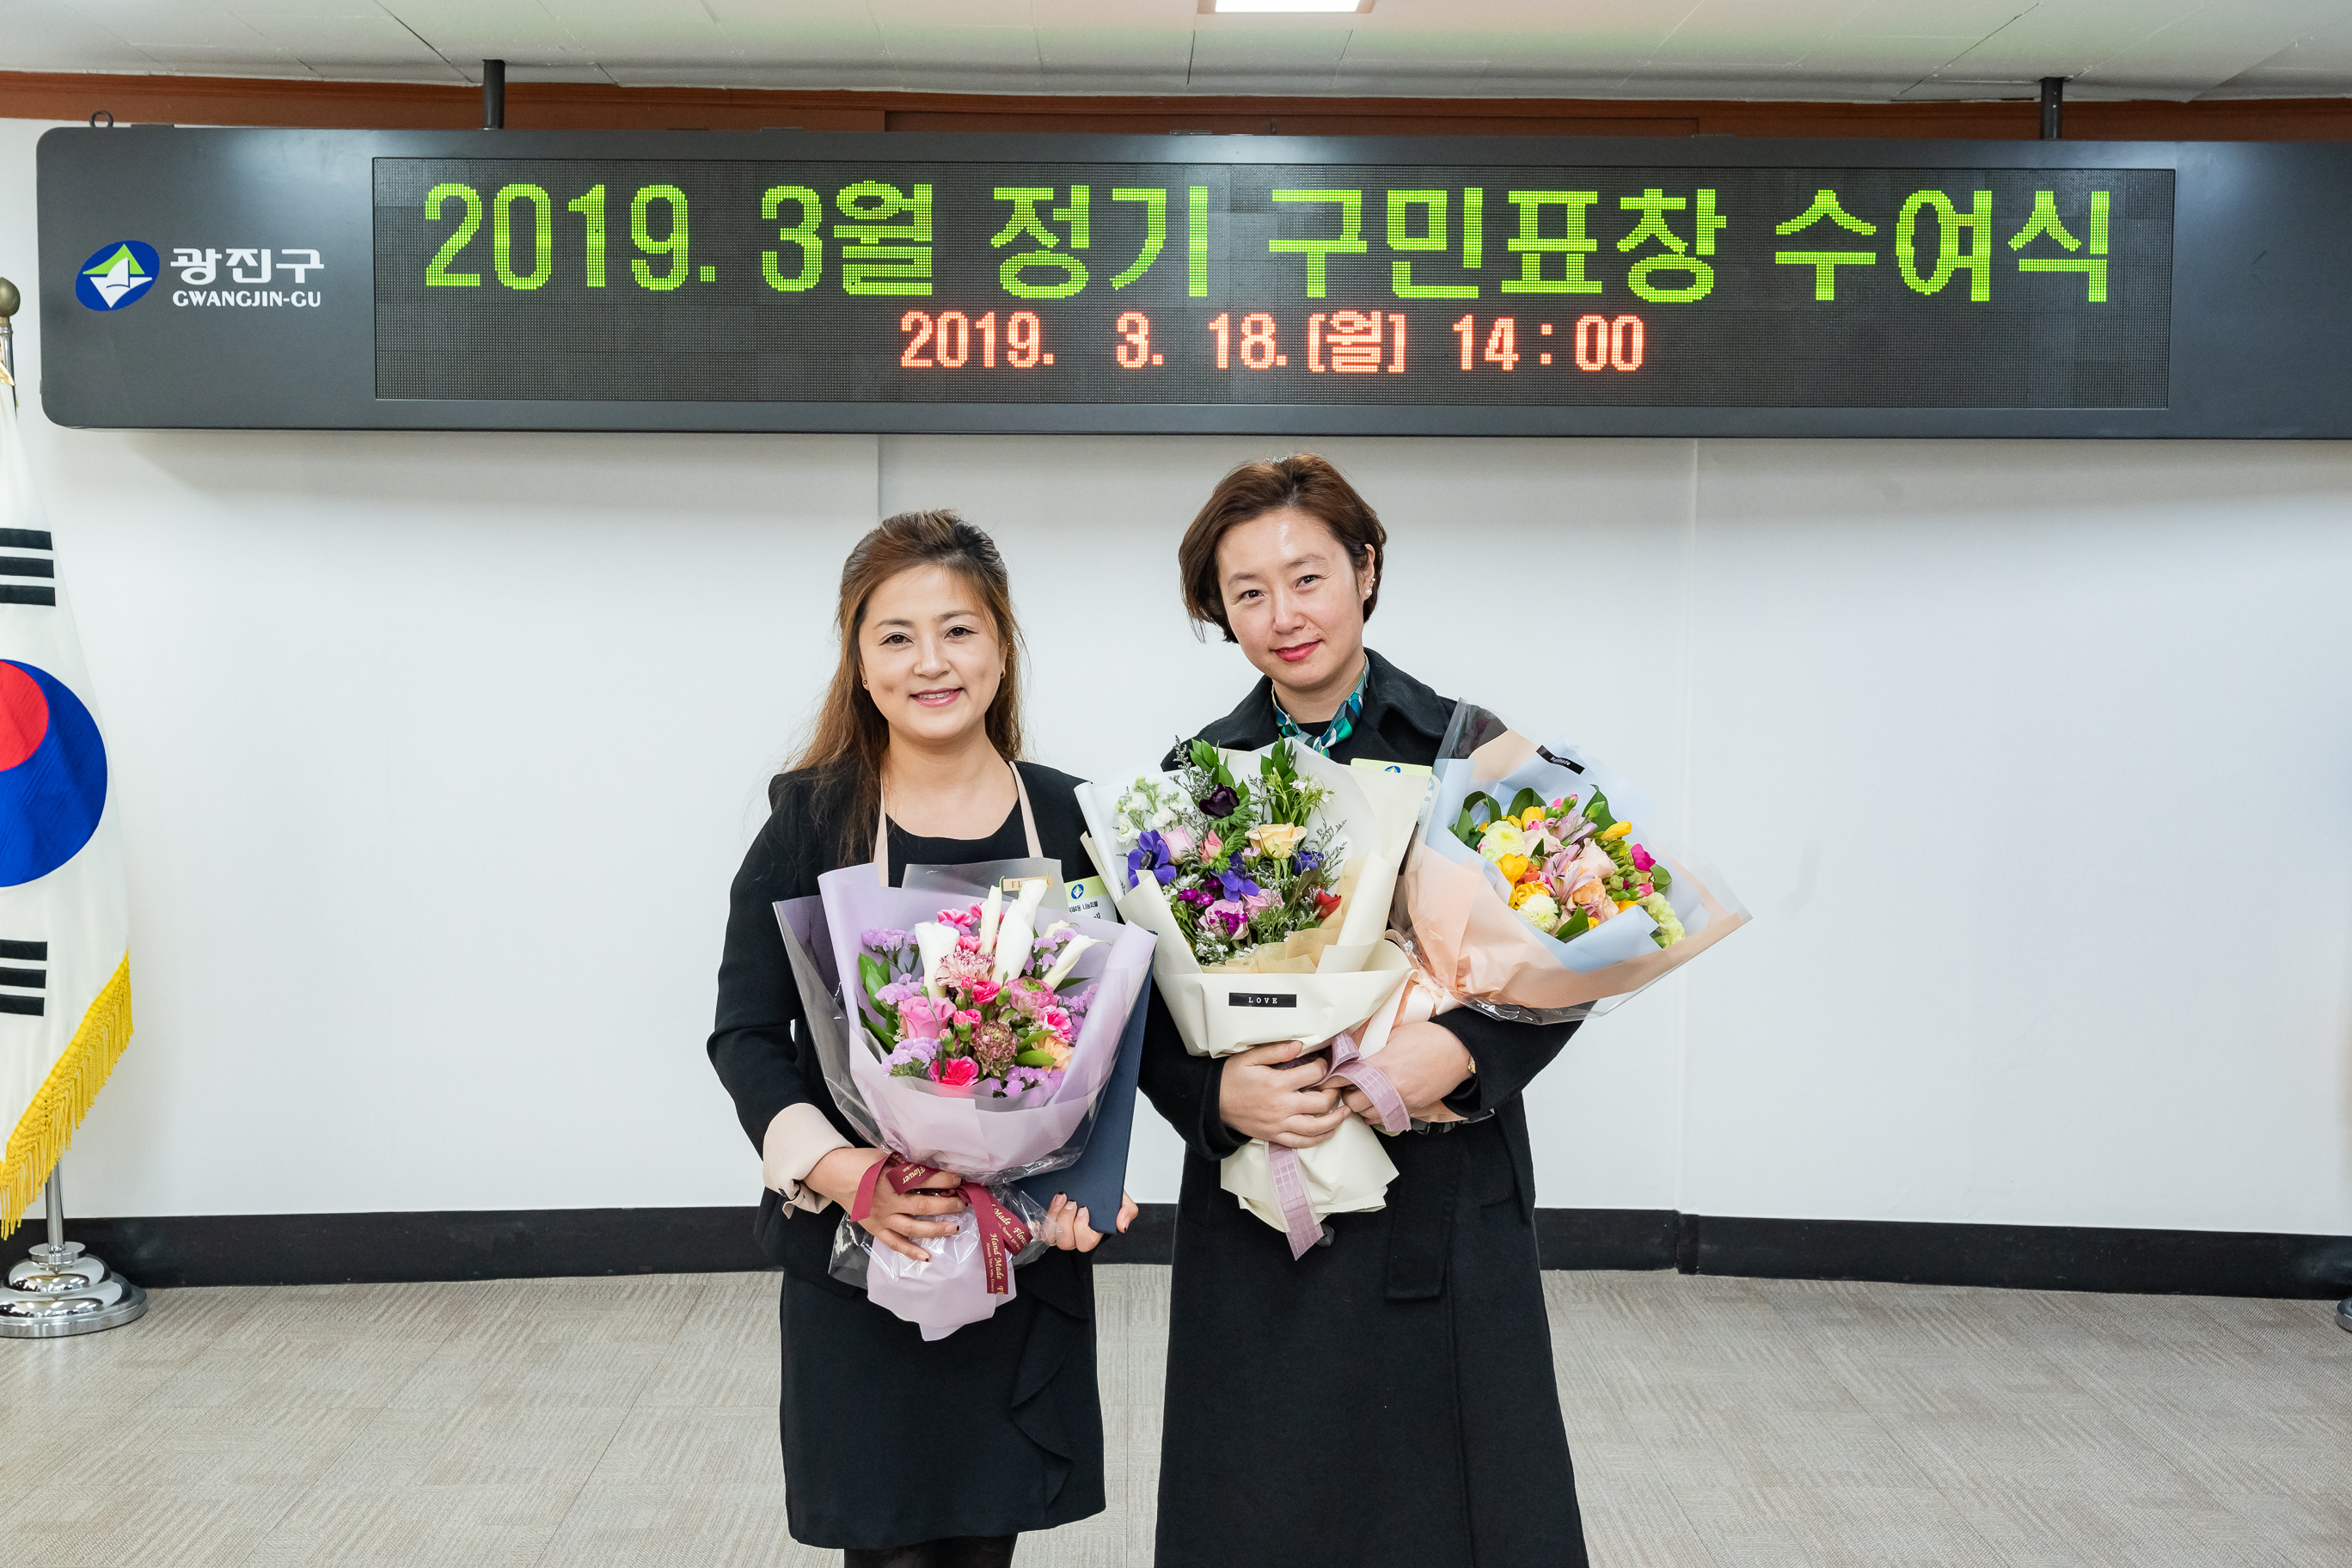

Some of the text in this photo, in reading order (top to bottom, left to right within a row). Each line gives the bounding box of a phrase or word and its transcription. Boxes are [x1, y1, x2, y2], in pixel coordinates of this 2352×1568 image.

[425, 180, 2110, 303] 2019. 3월 정기 구민표창 수여식
[170, 248, 325, 285] 광진구
[172, 290, 322, 308] GWANGJIN-GU
[899, 310, 1056, 369] 2019.
[1115, 310, 1164, 370] 3.
[902, 1166, 926, 1185] Flower
[993, 1207, 1012, 1226] Made
[989, 1233, 1002, 1257] Hand
[994, 1257, 1005, 1280] Made
